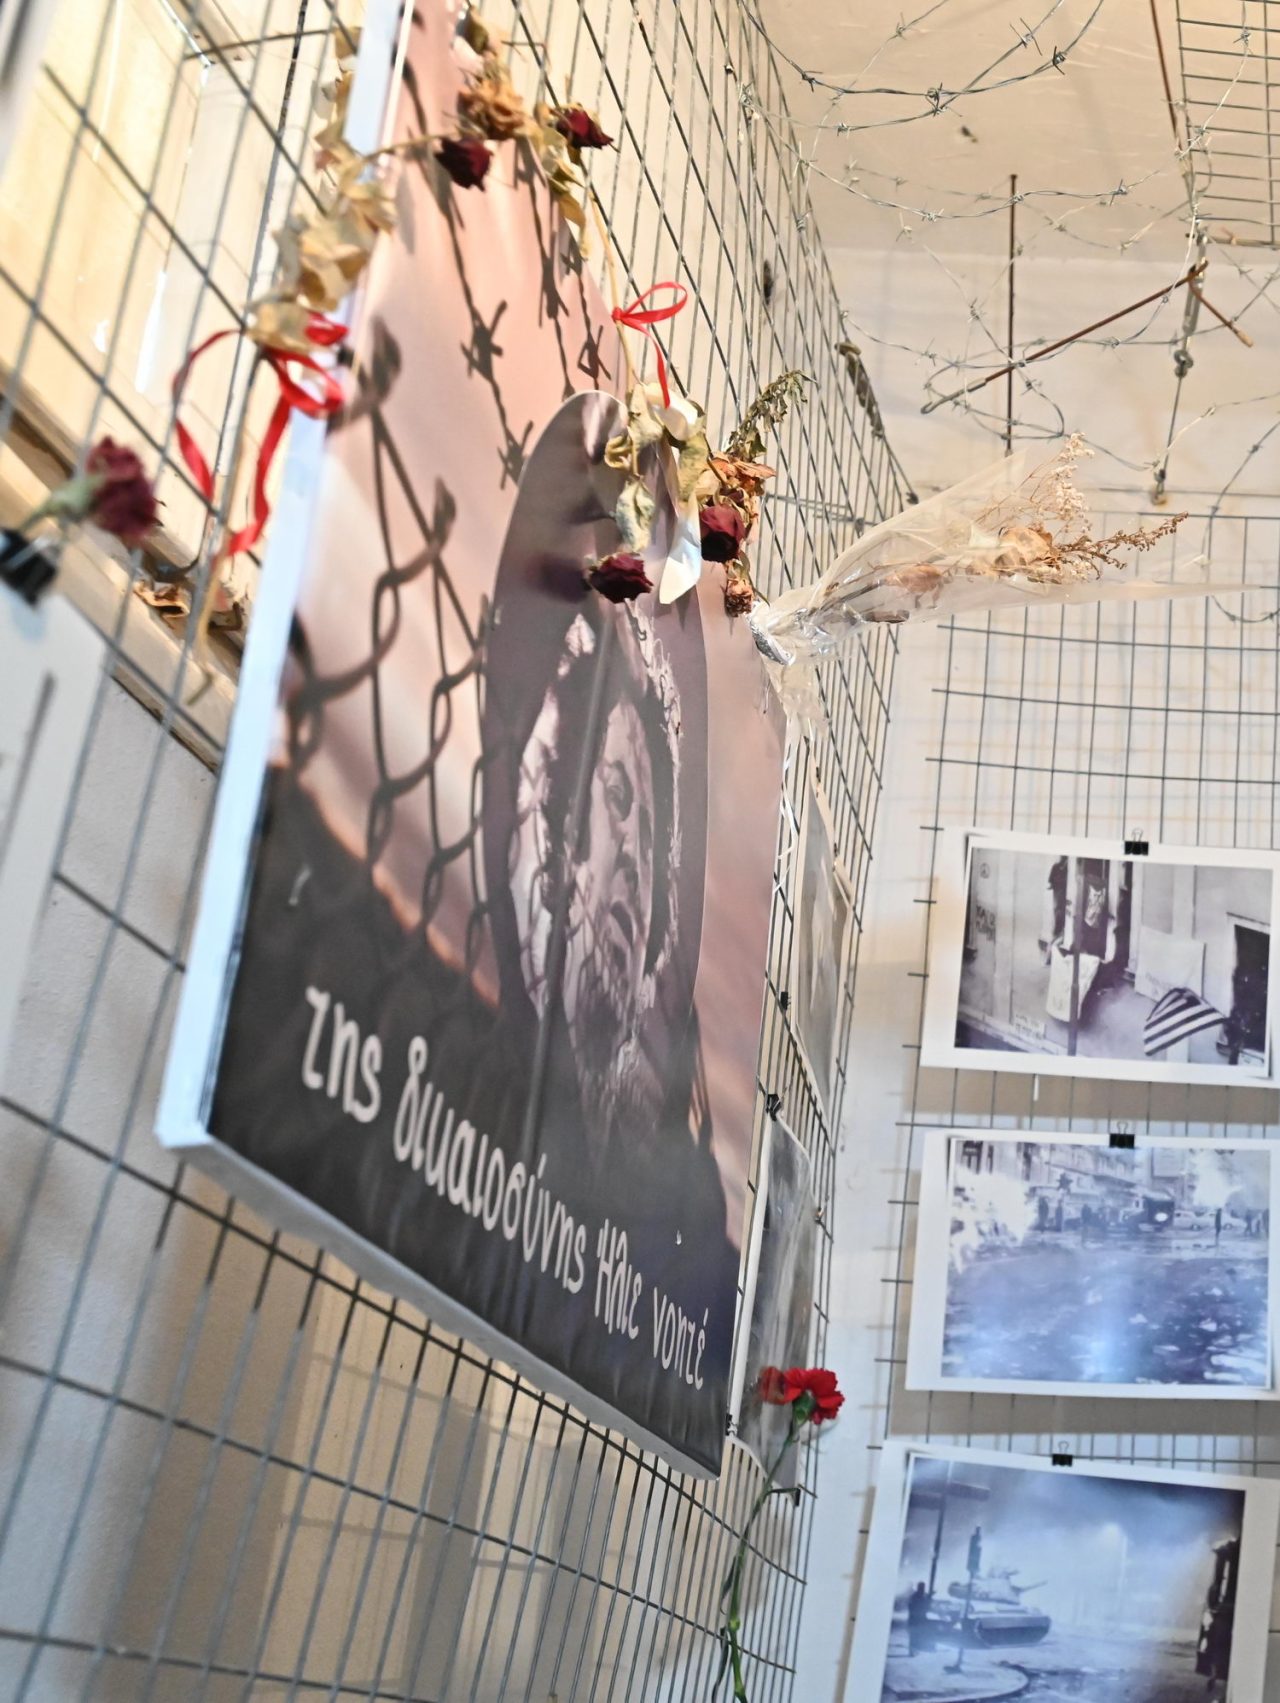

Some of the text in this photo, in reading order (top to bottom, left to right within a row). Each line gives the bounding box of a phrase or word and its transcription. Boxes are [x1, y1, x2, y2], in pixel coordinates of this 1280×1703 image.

[302, 986, 383, 1123] της
[393, 1035, 587, 1295] δικαιοσύνης
[653, 1286, 709, 1391] νοητέ
